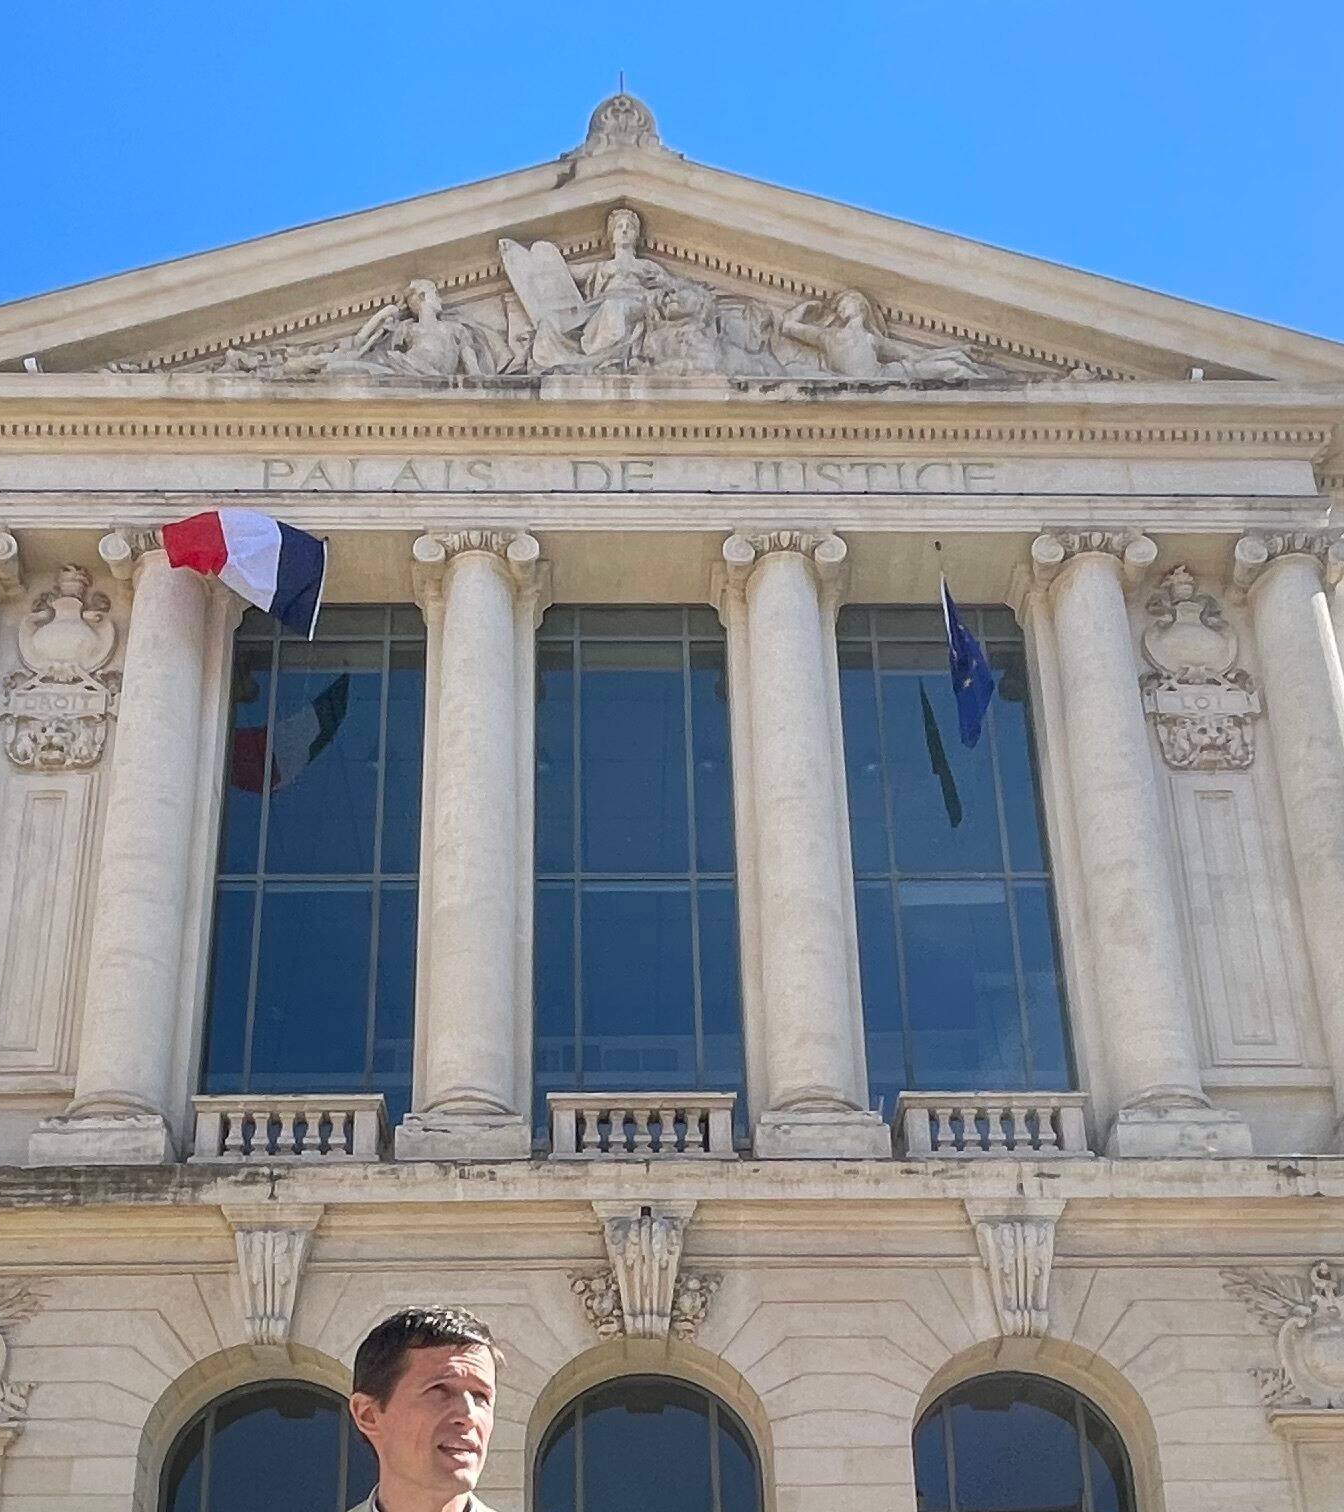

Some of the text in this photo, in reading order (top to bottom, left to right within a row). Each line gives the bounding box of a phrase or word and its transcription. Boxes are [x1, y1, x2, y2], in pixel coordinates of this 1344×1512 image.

[262, 457, 995, 493] PALAIS DE JUSTICE
